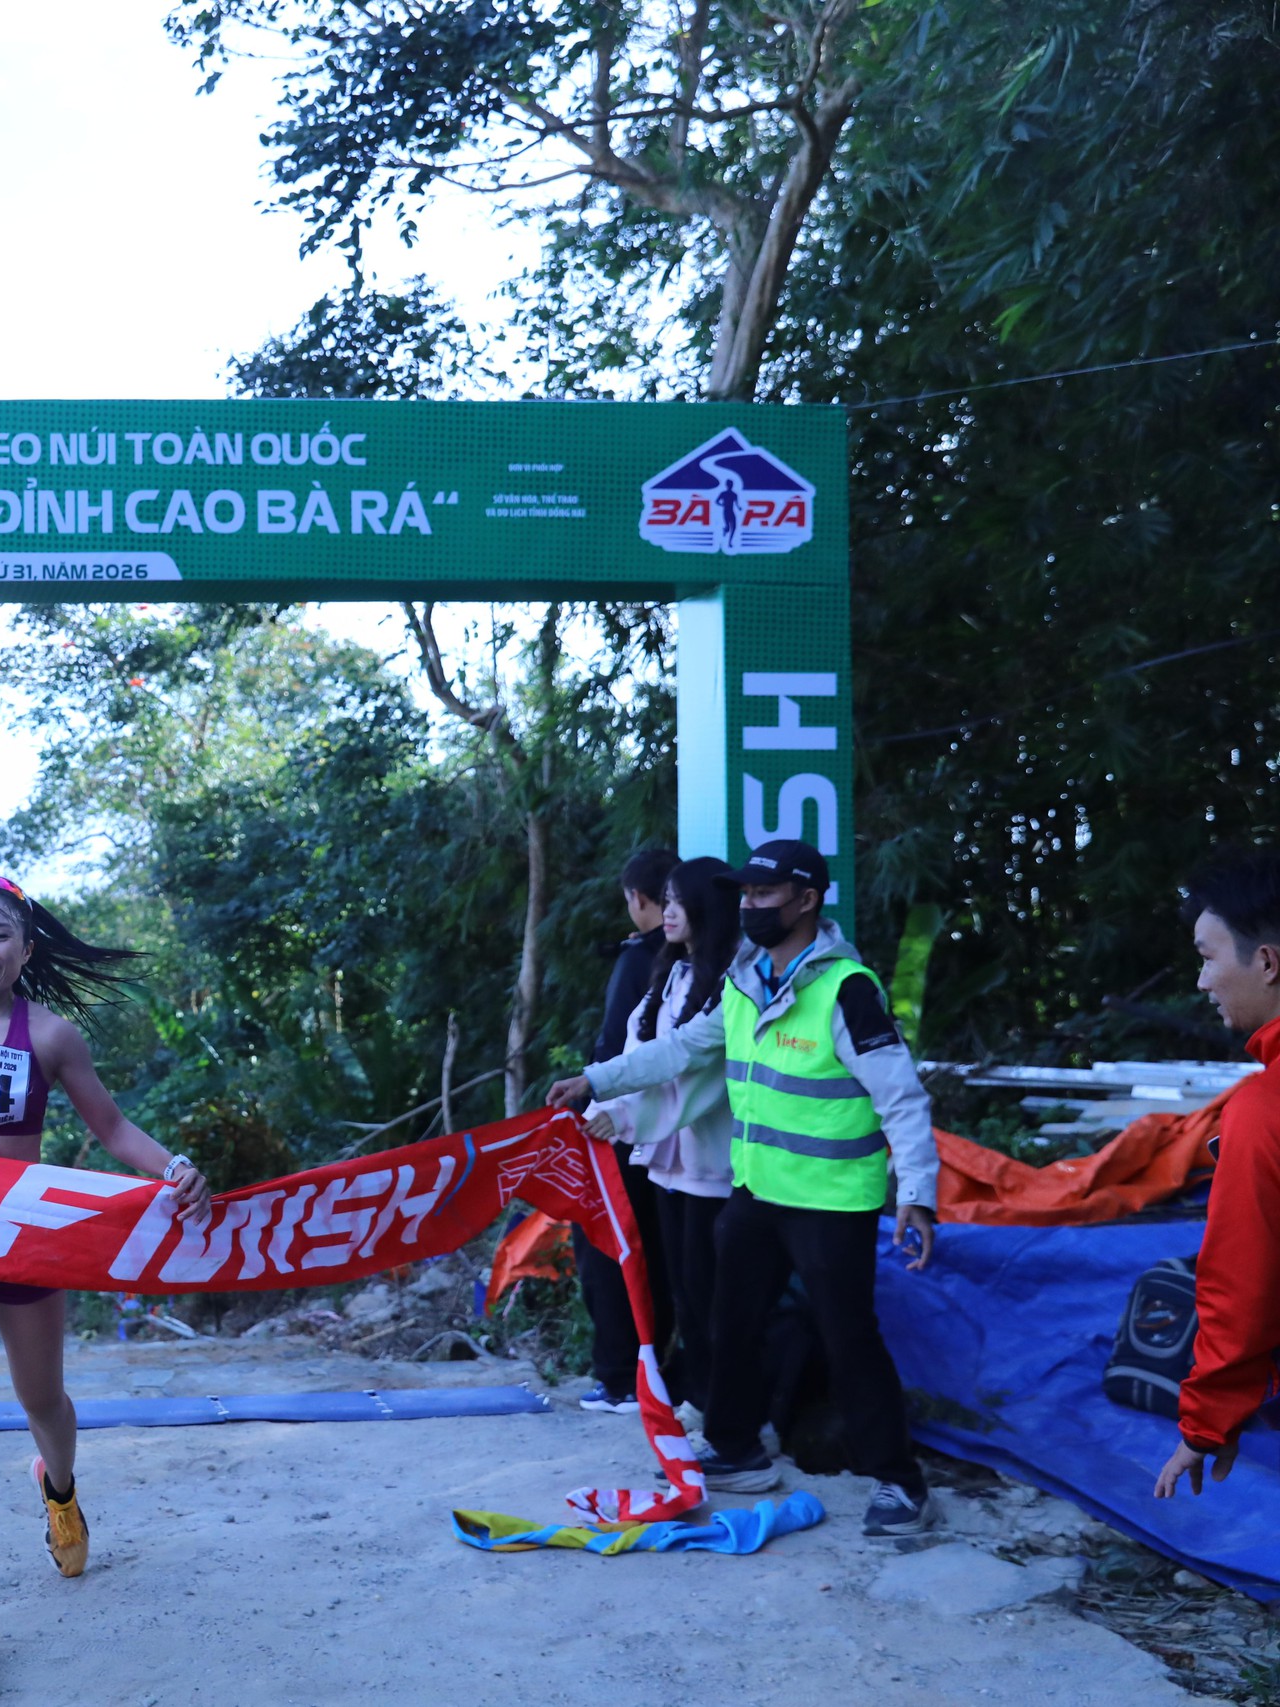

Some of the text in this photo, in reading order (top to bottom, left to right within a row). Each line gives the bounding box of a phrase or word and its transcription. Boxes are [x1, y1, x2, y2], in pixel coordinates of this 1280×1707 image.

[49, 426, 117, 466] NÚI
[125, 426, 243, 466] TOÀN
[250, 422, 367, 466] QUỐC
[124, 490, 252, 535] CAO
[258, 481, 340, 535] BÀ
[12, 564, 41, 582] 31,
[42, 560, 88, 580] NĂM
[91, 564, 149, 580] 2026
